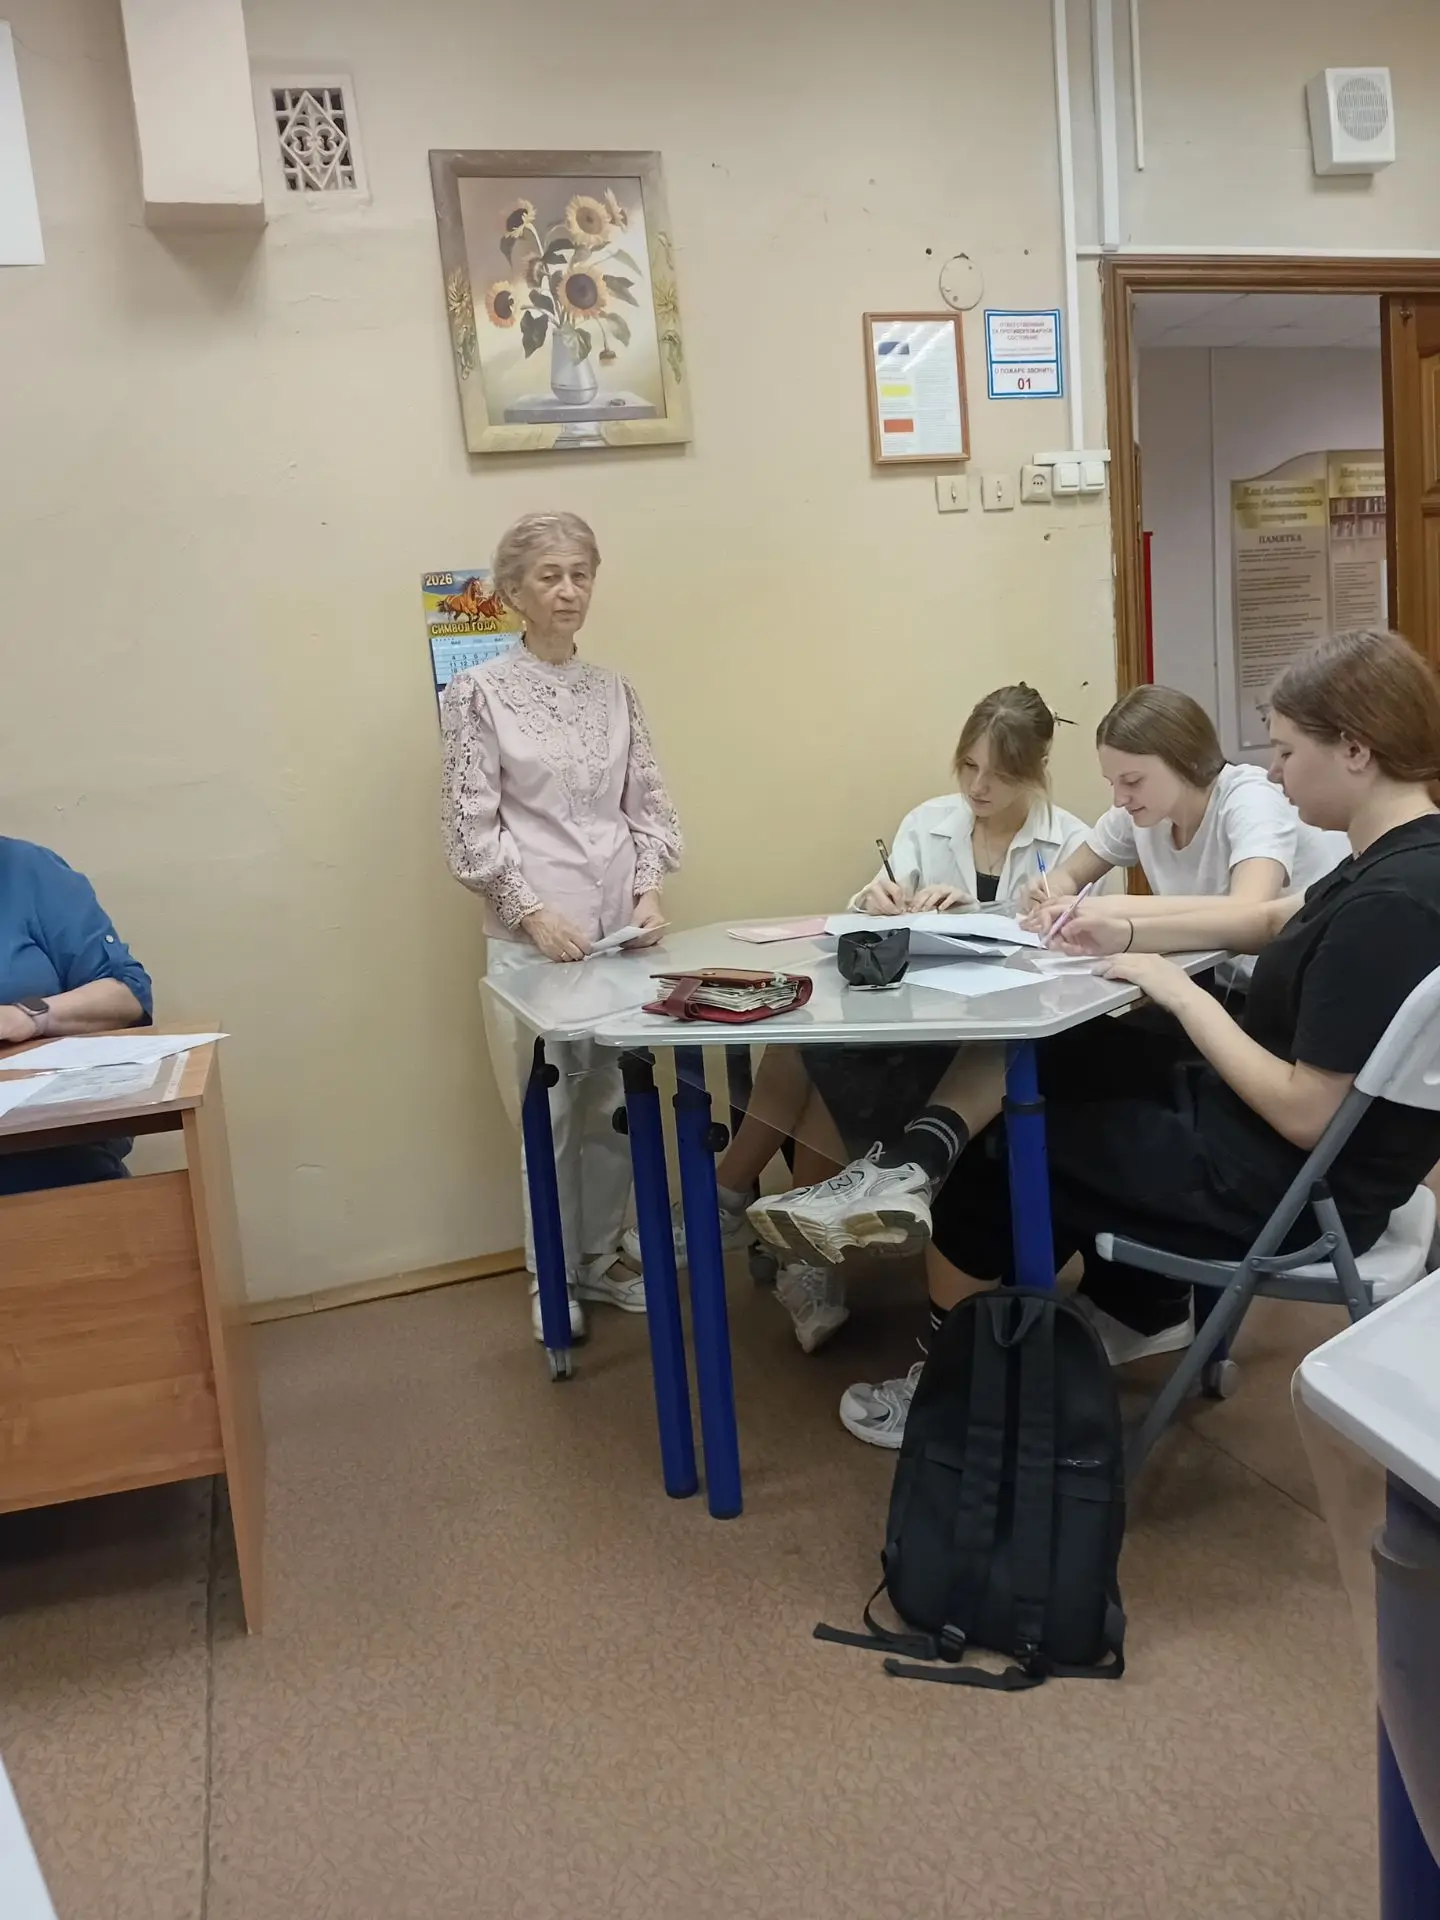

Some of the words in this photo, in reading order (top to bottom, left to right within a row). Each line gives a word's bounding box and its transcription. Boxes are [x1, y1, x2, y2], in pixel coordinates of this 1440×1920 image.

[1017, 377, 1031, 391] 01
[1259, 534, 1302, 544] ПАМЯТКА
[425, 573, 453, 586] 2026
[431, 622, 470, 635] СИМВОЛ
[471, 621, 497, 632] ГОДА
